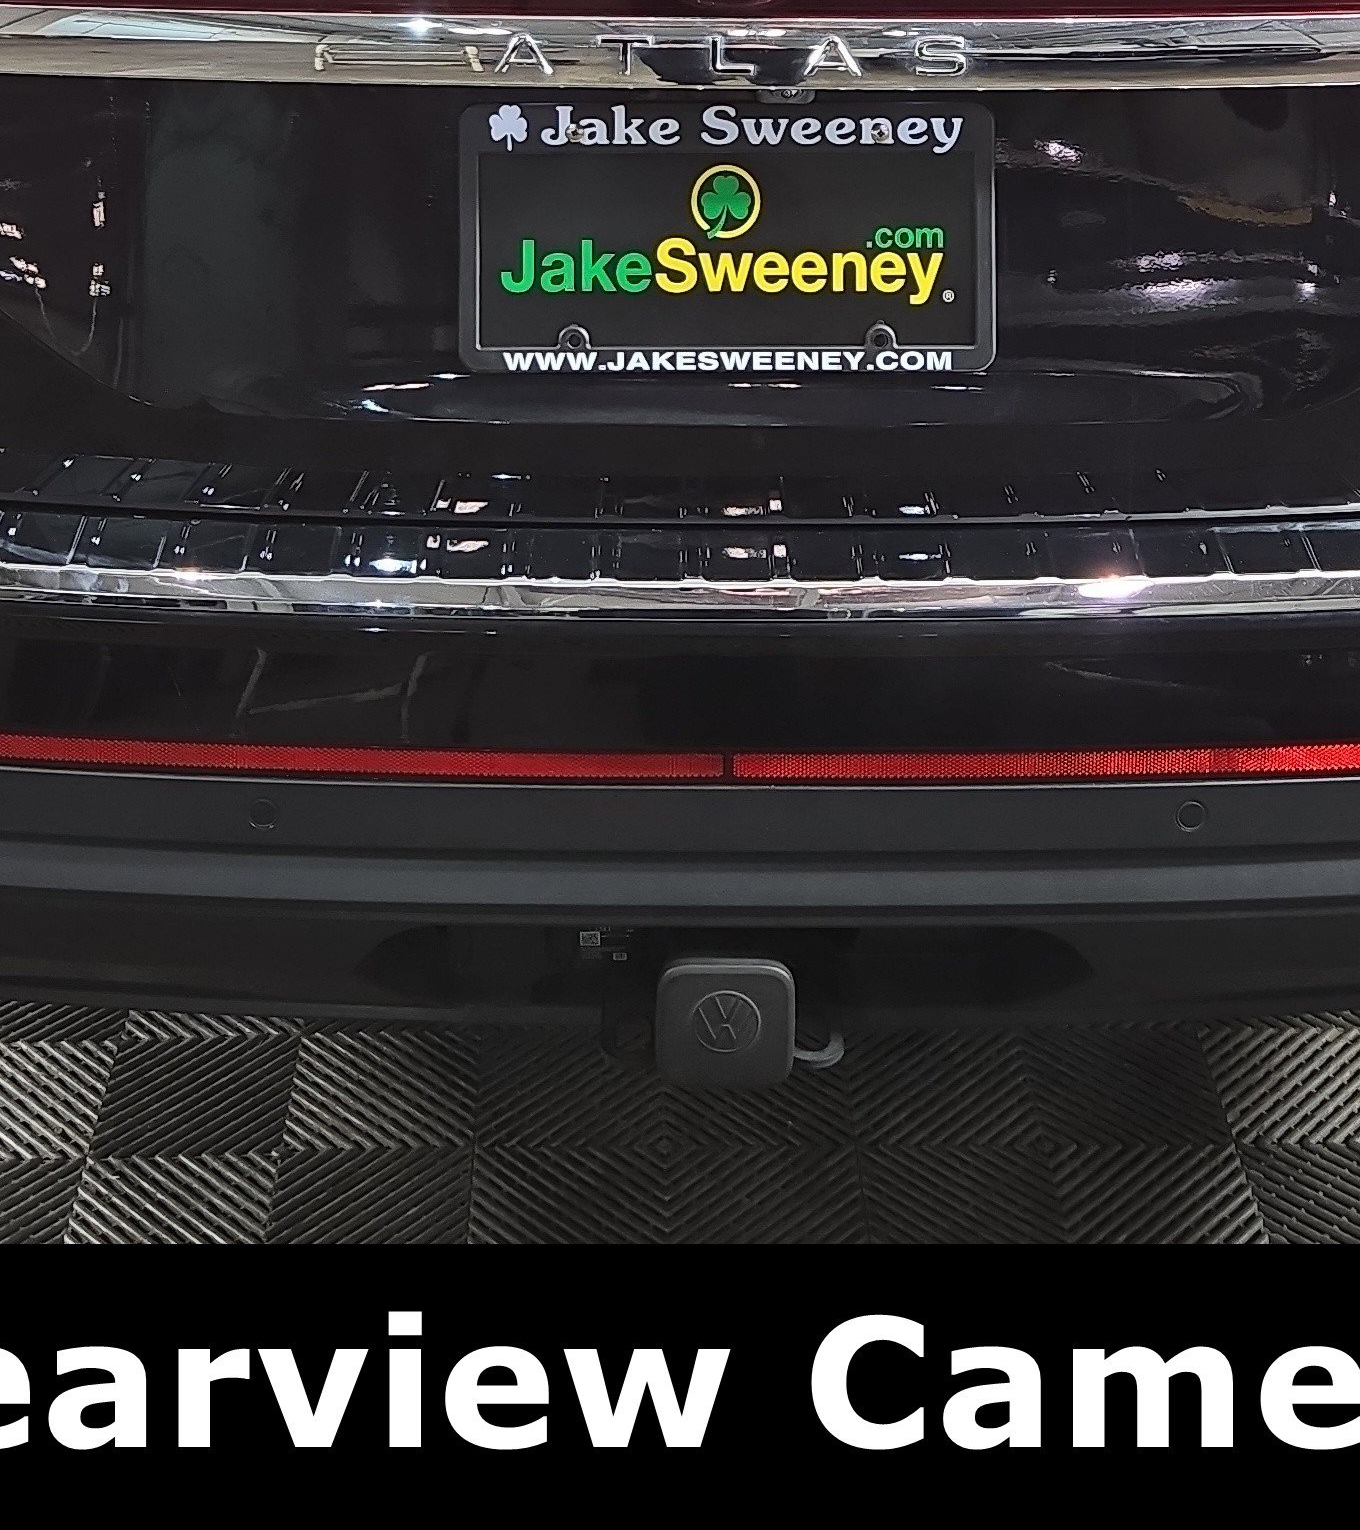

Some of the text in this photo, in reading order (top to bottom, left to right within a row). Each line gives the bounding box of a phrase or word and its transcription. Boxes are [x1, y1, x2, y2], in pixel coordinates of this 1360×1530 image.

[494, 34, 968, 79] ATLAS
[540, 105, 964, 154] Jake Sweeney
[502, 351, 953, 372] WWW.JAKESWEENEY.COM
